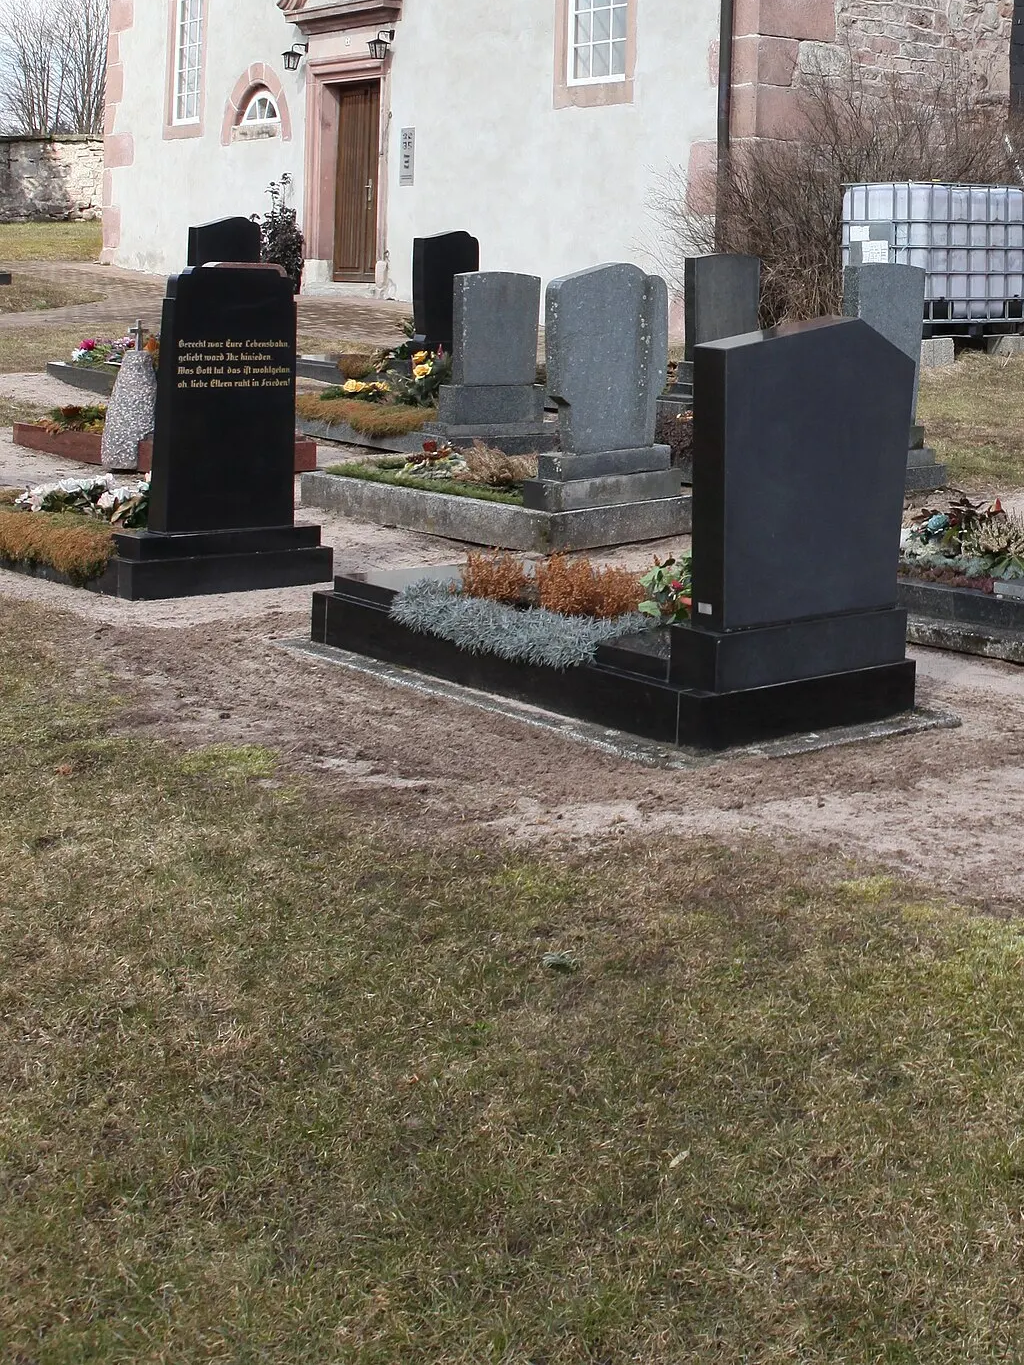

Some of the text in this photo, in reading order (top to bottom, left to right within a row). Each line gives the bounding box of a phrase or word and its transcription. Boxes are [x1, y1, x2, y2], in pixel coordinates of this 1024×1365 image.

[178, 339, 206, 348] Gerecht
[225, 339, 243, 348] Eure
[178, 352, 203, 363] geliebt
[226, 352, 239, 361] Ihr
[177, 366, 194, 375] Was
[195, 365, 212, 375] Gott
[227, 365, 241, 374] das
[190, 379, 208, 388] liebe
[210, 378, 233, 388] Eltern
[234, 378, 250, 387] ruht
[251, 378, 260, 387] in
[261, 378, 291, 387] Frieden!
